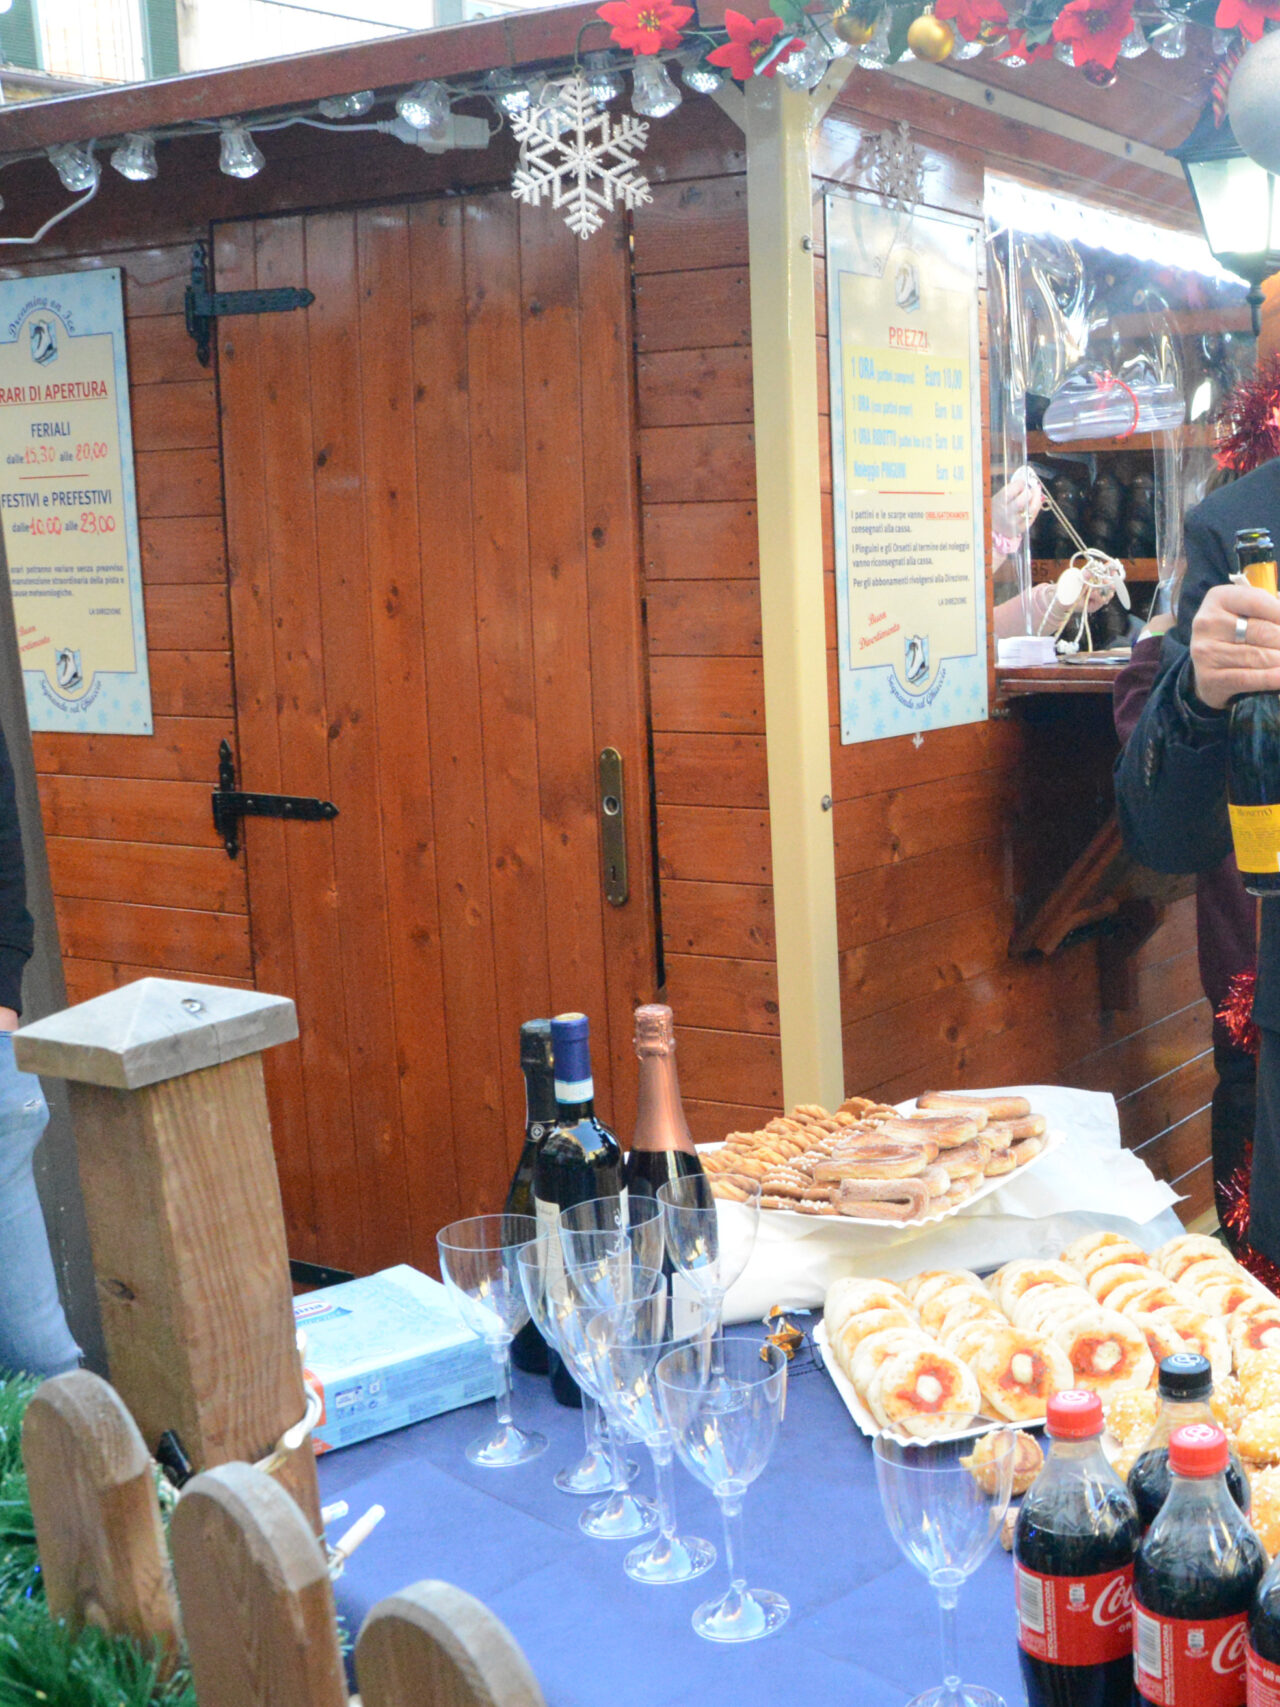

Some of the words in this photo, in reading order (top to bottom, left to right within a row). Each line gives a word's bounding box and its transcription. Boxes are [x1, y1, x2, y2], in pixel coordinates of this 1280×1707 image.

[889, 326, 928, 348] PREZZI
[858, 356, 875, 380] ORA
[0, 386, 26, 403] RARI
[29, 385, 41, 402] DI
[45, 380, 108, 400] APERTURA
[31, 421, 71, 438] FERIALI
[6, 453, 24, 465] dalle
[60, 451, 73, 462] alle
[1, 492, 40, 508] FESTIVI
[43, 495, 49, 507] e
[52, 489, 112, 506] PREFESTIVI
[855, 510, 874, 521] pattini
[888, 511, 906, 521] scarpe
[907, 511, 925, 519] vanno
[12, 522, 29, 533] dalle
[65, 521, 78, 532] alle
[851, 524, 883, 535] consegnati
[884, 523, 895, 533] alla
[855, 543, 880, 555] Pinguini
[893, 543, 912, 553] Orsetti
[918, 542, 938, 552] termine
[853, 559, 871, 568] vanno
[871, 557, 906, 568] riconsegnati
[853, 578, 863, 588] Per
[872, 575, 909, 587] abbonamenti
[1092, 1575, 1134, 1627] Coc
[1211, 1620, 1248, 1676] Co
